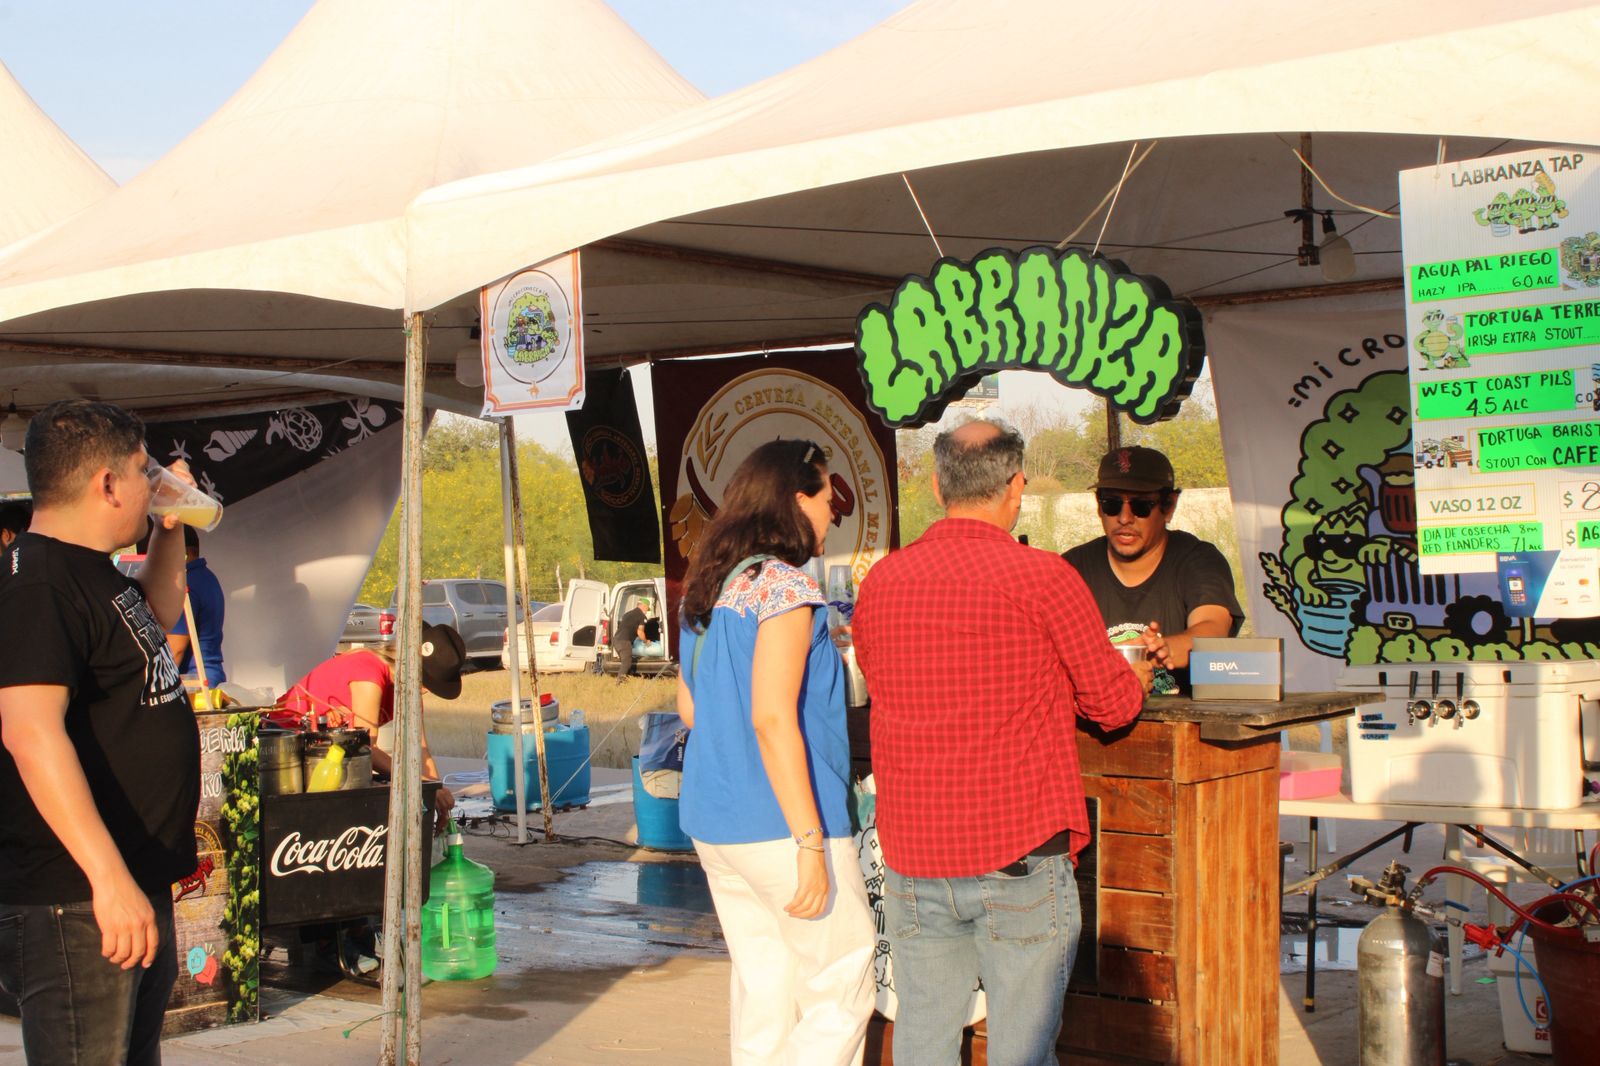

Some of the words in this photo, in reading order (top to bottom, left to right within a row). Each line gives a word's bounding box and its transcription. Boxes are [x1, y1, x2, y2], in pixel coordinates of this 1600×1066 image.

[1451, 159, 1544, 188] LABRANZA
[1549, 154, 1584, 173] TAP
[1417, 263, 1461, 280] AGUA
[1465, 259, 1493, 273] PAL
[1500, 252, 1553, 269] RIEGO
[1418, 285, 1446, 297] HAZY
[1457, 282, 1477, 293] IPA
[1465, 308, 1544, 328] TORTUGA
[861, 253, 1183, 421] LABRANZA
[1468, 333, 1497, 347] IRISH
[1503, 331, 1536, 344] EXTRA
[1545, 326, 1583, 341] STOUT
[1422, 380, 1478, 398] WEST
[1486, 375, 1532, 391] COAST
[1540, 370, 1572, 387] PILS
[1502, 399, 1529, 412] ALC
[734, 387, 807, 415] CERVEZA
[811, 401, 878, 503] ARTESANAL
[1477, 427, 1542, 447] TORTUGA
[1485, 456, 1521, 469] STOUT
[1552, 445, 1599, 465] CAFE
[1430, 499, 1472, 513] VASO
[1476, 497, 1496, 511] 12
[1500, 496, 1522, 510] OZ
[1423, 529, 1442, 542] DIA
[1444, 527, 1458, 539] DE
[1461, 524, 1511, 537] COSECHA
[1422, 542, 1442, 554] RED
[1446, 537, 1500, 552] FLANDERS
[1209, 661, 1239, 671] BBVA
[270, 825, 389, 877] Coca-Cola
